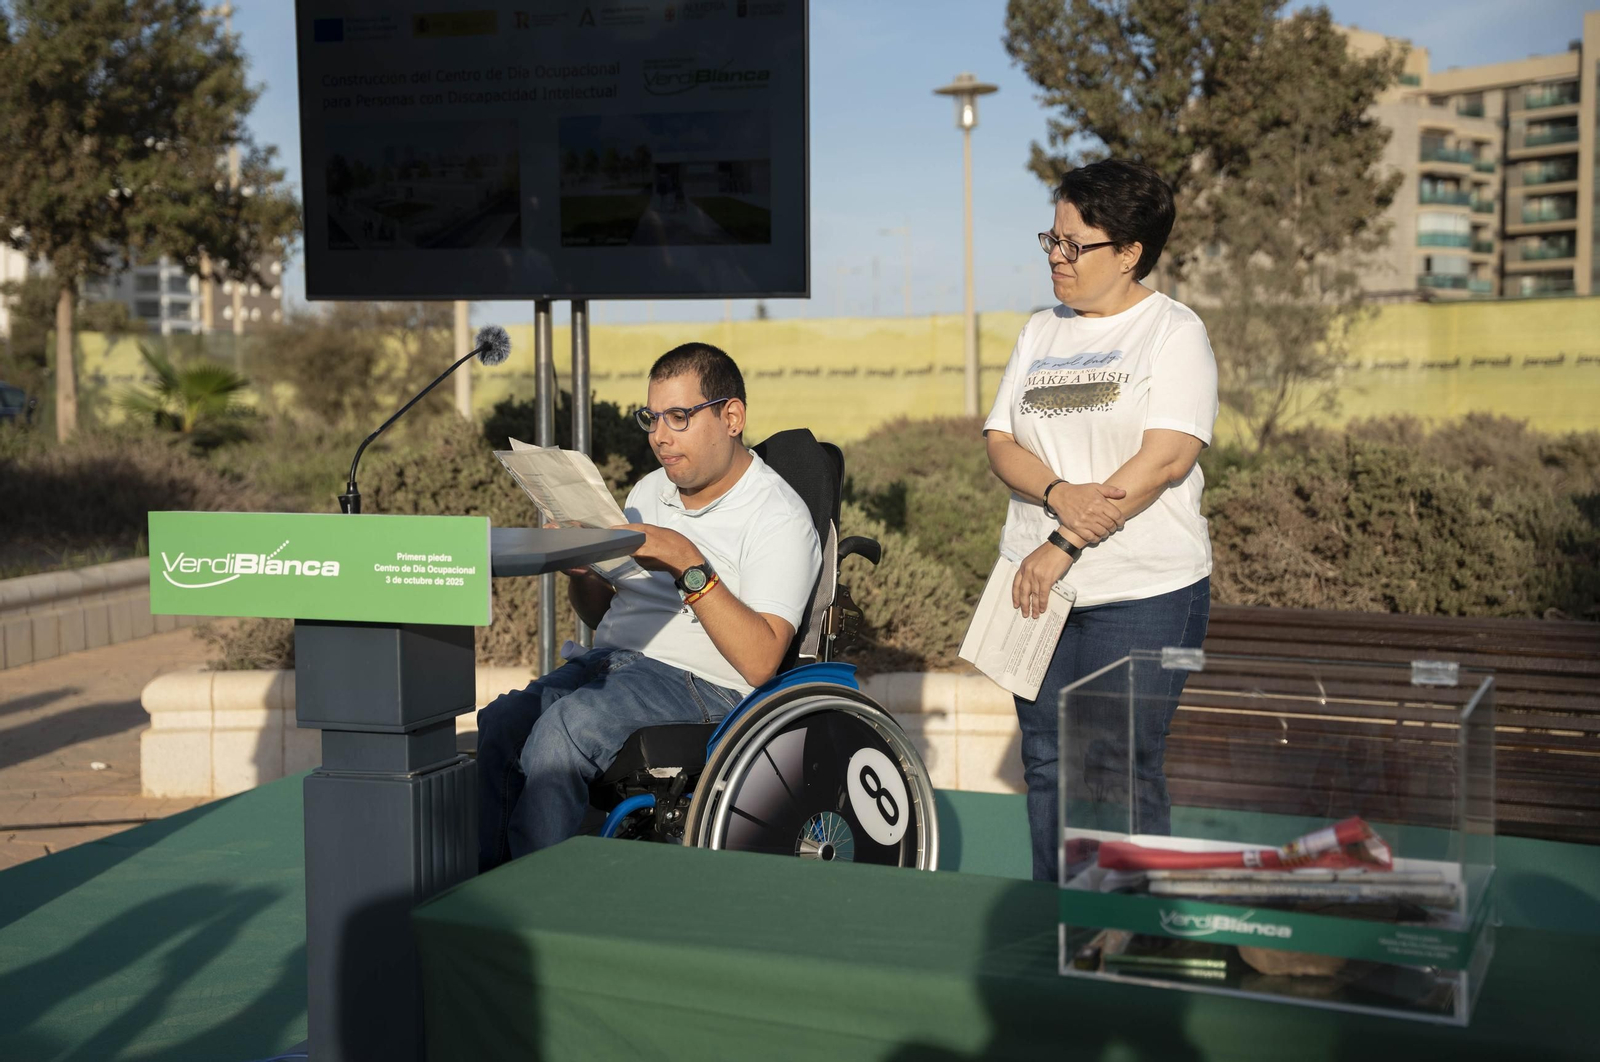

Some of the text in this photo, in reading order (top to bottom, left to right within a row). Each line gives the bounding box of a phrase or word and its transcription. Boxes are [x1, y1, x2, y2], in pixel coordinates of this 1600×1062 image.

[322, 61, 621, 87] Construcción del Centro de Día Ocupacional
[322, 84, 618, 110] para Personas con Discapacidad Intelectual
[1025, 371, 1131, 387] MAKE A WISH
[396, 552, 453, 563] Primera piedra
[374, 563, 476, 575] Centro de Día Ocupacional
[385, 576, 464, 586] 3 de octubre de 2025
[860, 765, 899, 826] 8
